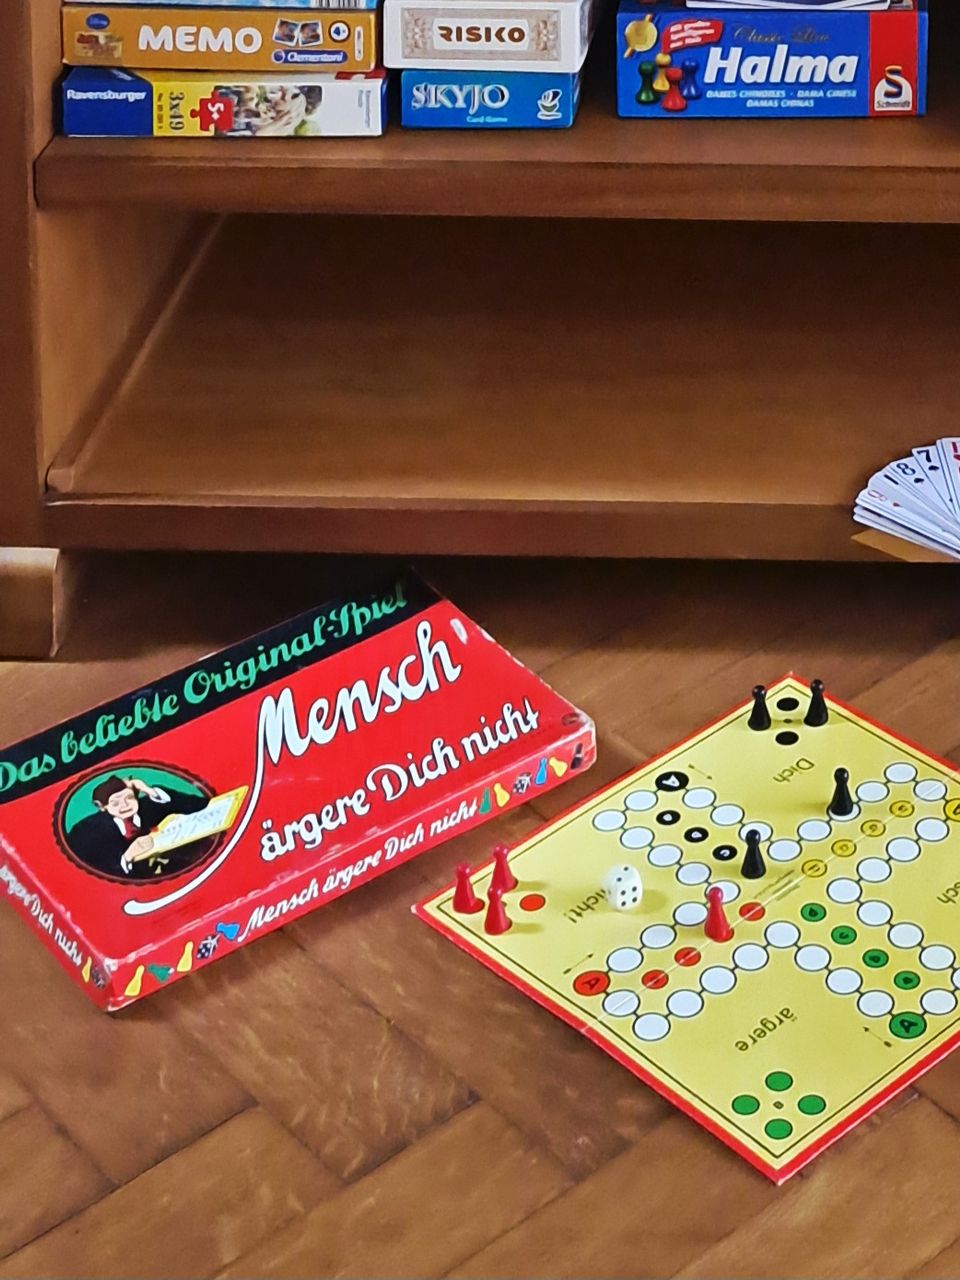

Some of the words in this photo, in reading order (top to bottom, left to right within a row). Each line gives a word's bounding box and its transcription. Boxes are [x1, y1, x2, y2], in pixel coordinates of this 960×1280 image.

[138, 25, 262, 54] MEMO
[437, 26, 526, 43] RISIKO
[703, 44, 859, 84] Halma
[66, 89, 147, 101] Ravensburger
[169, 91, 185, 131] 3x49
[412, 82, 509, 114] SKYJO
[0, 753, 56, 792] Das
[61, 691, 180, 758] beliebte
[183, 583, 408, 706] Original-Spiel
[260, 787, 370, 862] ärgere
[366, 740, 459, 802] Dich
[463, 697, 539, 759] nicht
[660, 774, 681, 788] A
[772, 756, 816, 785] Dich
[237, 879, 320, 943] Mensch
[322, 846, 385, 897] ärgere
[383, 823, 426, 865] Dich
[428, 798, 478, 841] nicht
[560, 888, 609, 924] icht!
[31, 893, 53, 934] Dich
[54, 928, 82, 966] nicht
[581, 976, 602, 992] A
[734, 1006, 797, 1053] ärgere
[898, 1015, 920, 1034] A
